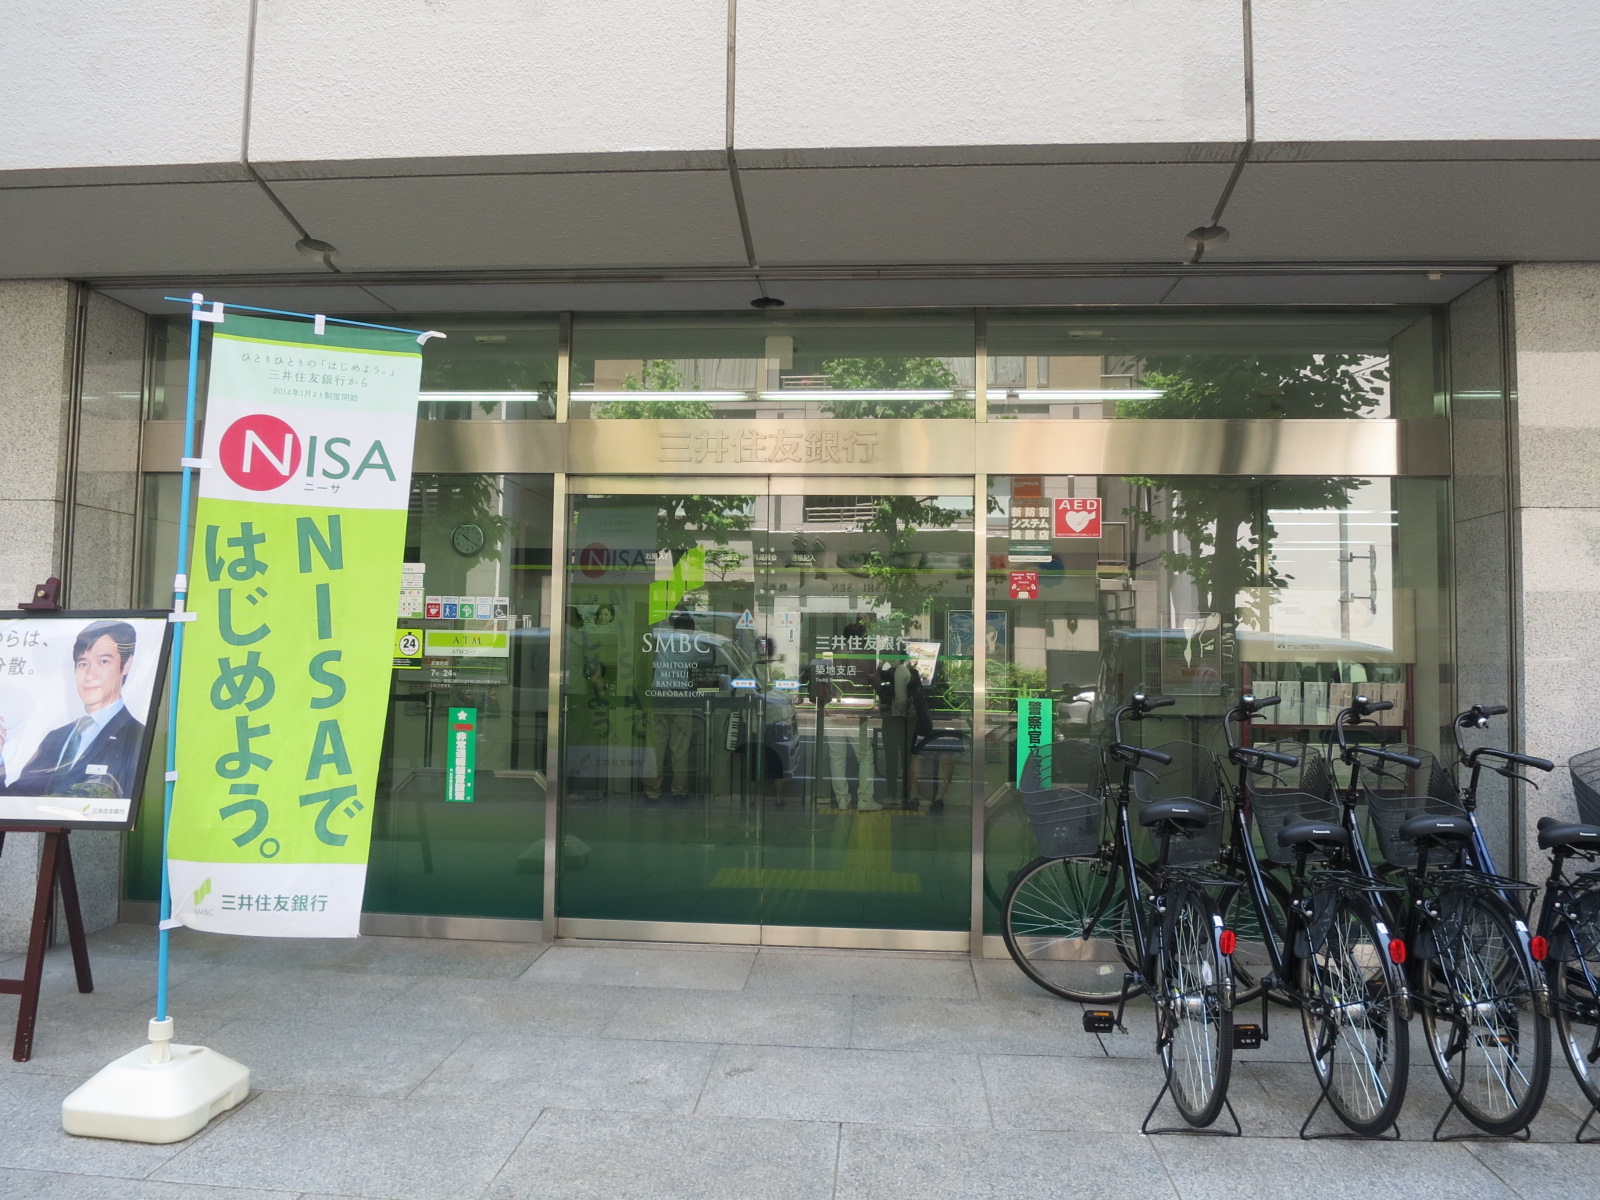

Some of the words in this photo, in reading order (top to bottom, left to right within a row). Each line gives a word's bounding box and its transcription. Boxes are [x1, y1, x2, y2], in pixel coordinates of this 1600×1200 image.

[241, 353, 395, 377] ひとりひとりの「はじめよう。」
[268, 369, 368, 388] 三井住友銀行から
[273, 387, 358, 402] 2014年1月より制度開始
[658, 429, 878, 464] 三井住友銀行
[242, 429, 397, 482] NISA
[303, 483, 341, 494] ニーサ
[1059, 499, 1098, 510] AED
[1011, 518, 1050, 529] システム
[588, 549, 649, 571] NISA
[403, 638, 416, 649] 24
[453, 636, 482, 645] ATM
[642, 633, 711, 653] SMBC
[815, 635, 911, 651] 三井住友銀行
[652, 661, 698, 669] SUMITOMO
[815, 664, 857, 676] 築地支店
[296, 514, 364, 846] NISAで
[656, 680, 694, 688] BANKING
[205, 522, 280, 858] はじめよう。
[644, 690, 705, 698] CORPORATION
[221, 894, 328, 912] 三井住友銀行
